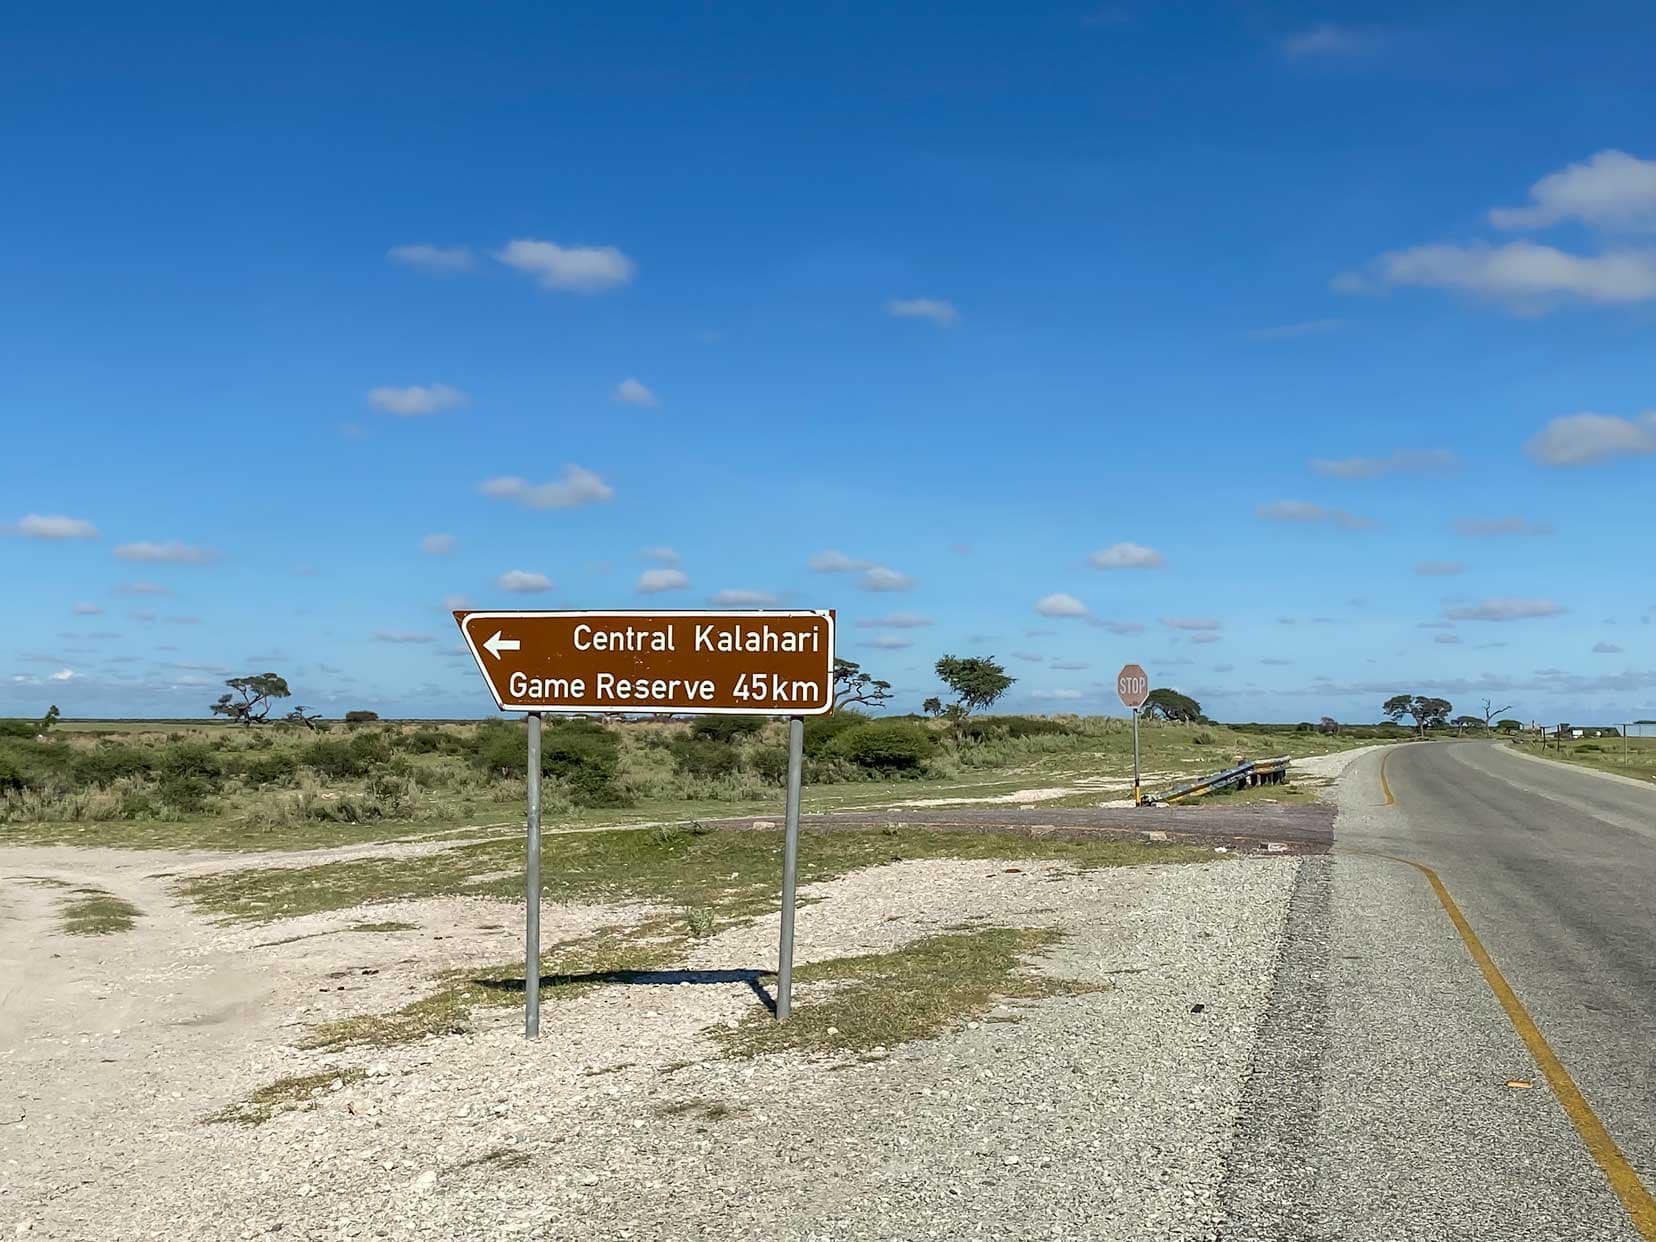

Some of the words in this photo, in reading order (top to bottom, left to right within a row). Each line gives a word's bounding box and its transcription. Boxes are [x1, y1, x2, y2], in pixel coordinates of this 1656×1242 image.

[573, 624, 675, 651] Central
[695, 624, 819, 652] Kalahari
[509, 671, 586, 698] Game
[597, 672, 715, 700] Reserve
[732, 673, 819, 702] 45km
[1119, 676, 1146, 694] STOP
